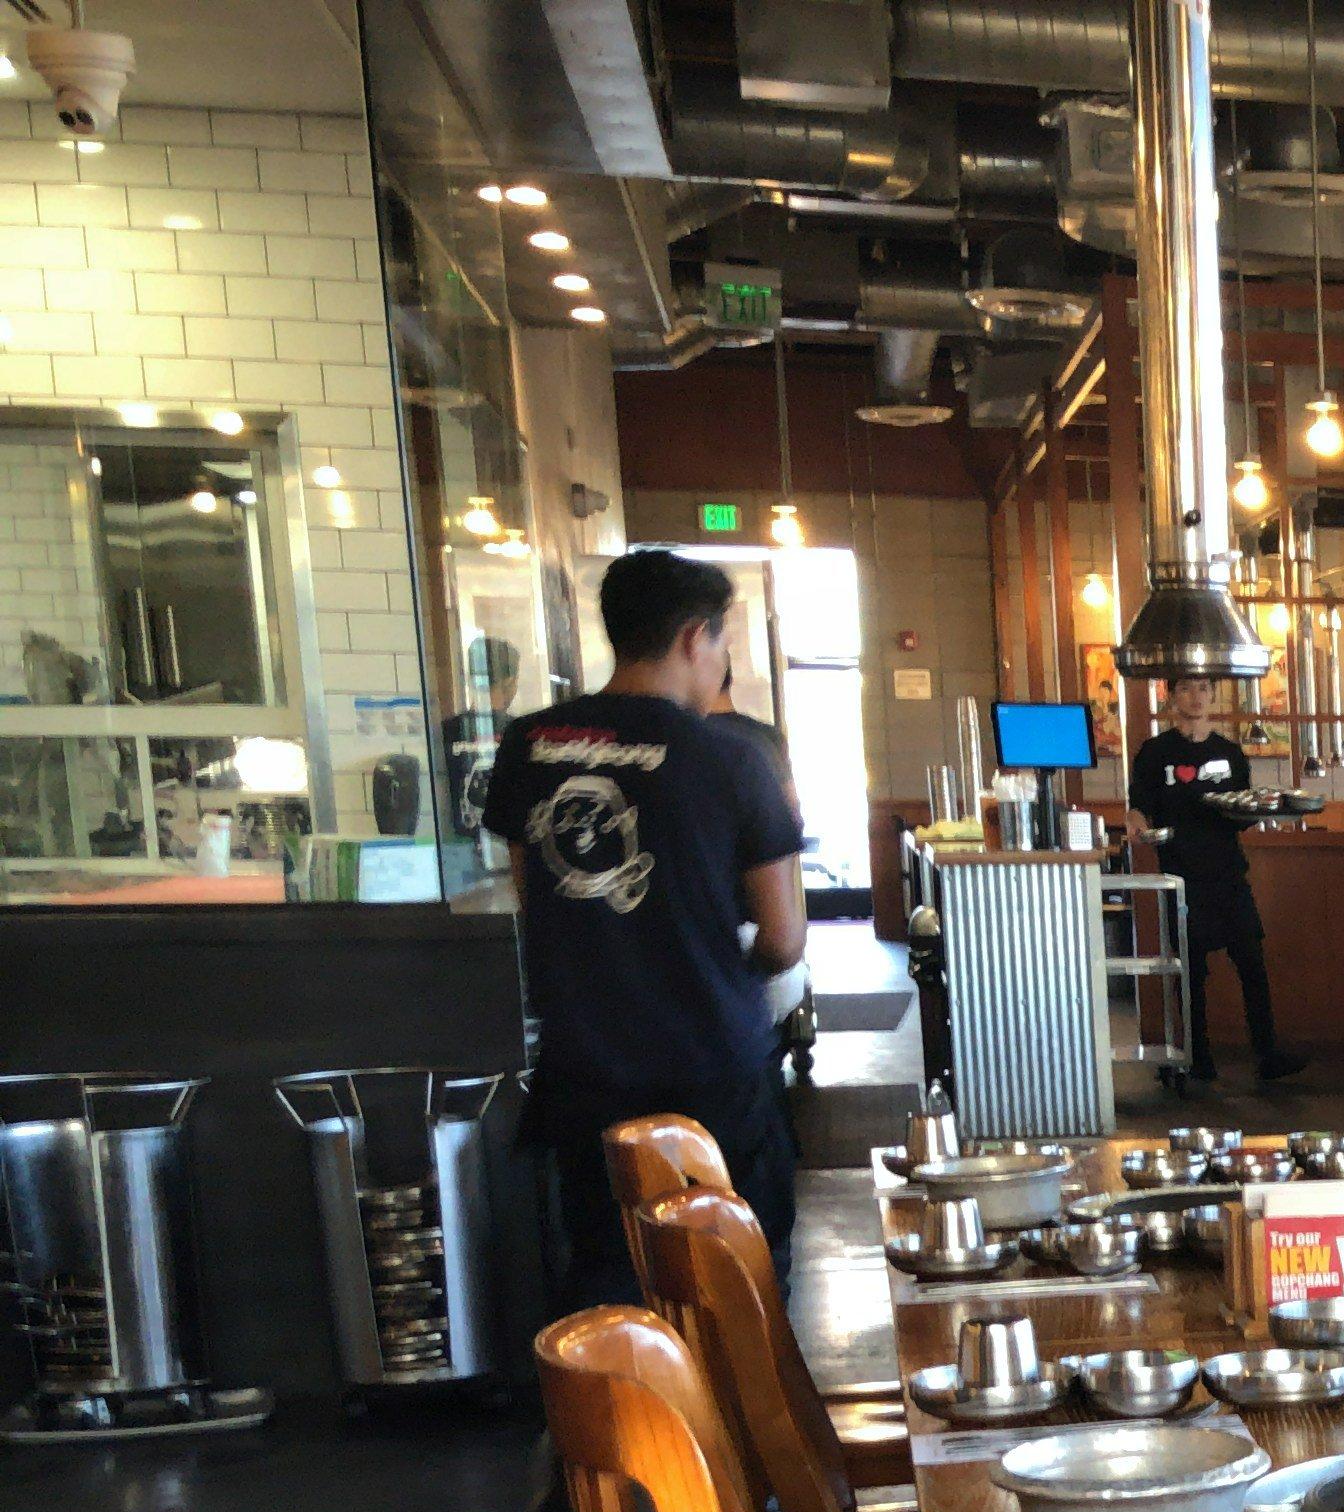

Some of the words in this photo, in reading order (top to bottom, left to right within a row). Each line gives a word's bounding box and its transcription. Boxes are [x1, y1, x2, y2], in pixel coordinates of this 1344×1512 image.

[721, 283, 772, 322] EXIT
[704, 505, 736, 529] EXIT
[1270, 1231, 1293, 1247] Try
[1296, 1231, 1322, 1246] our
[1270, 1246, 1331, 1275] NEW
